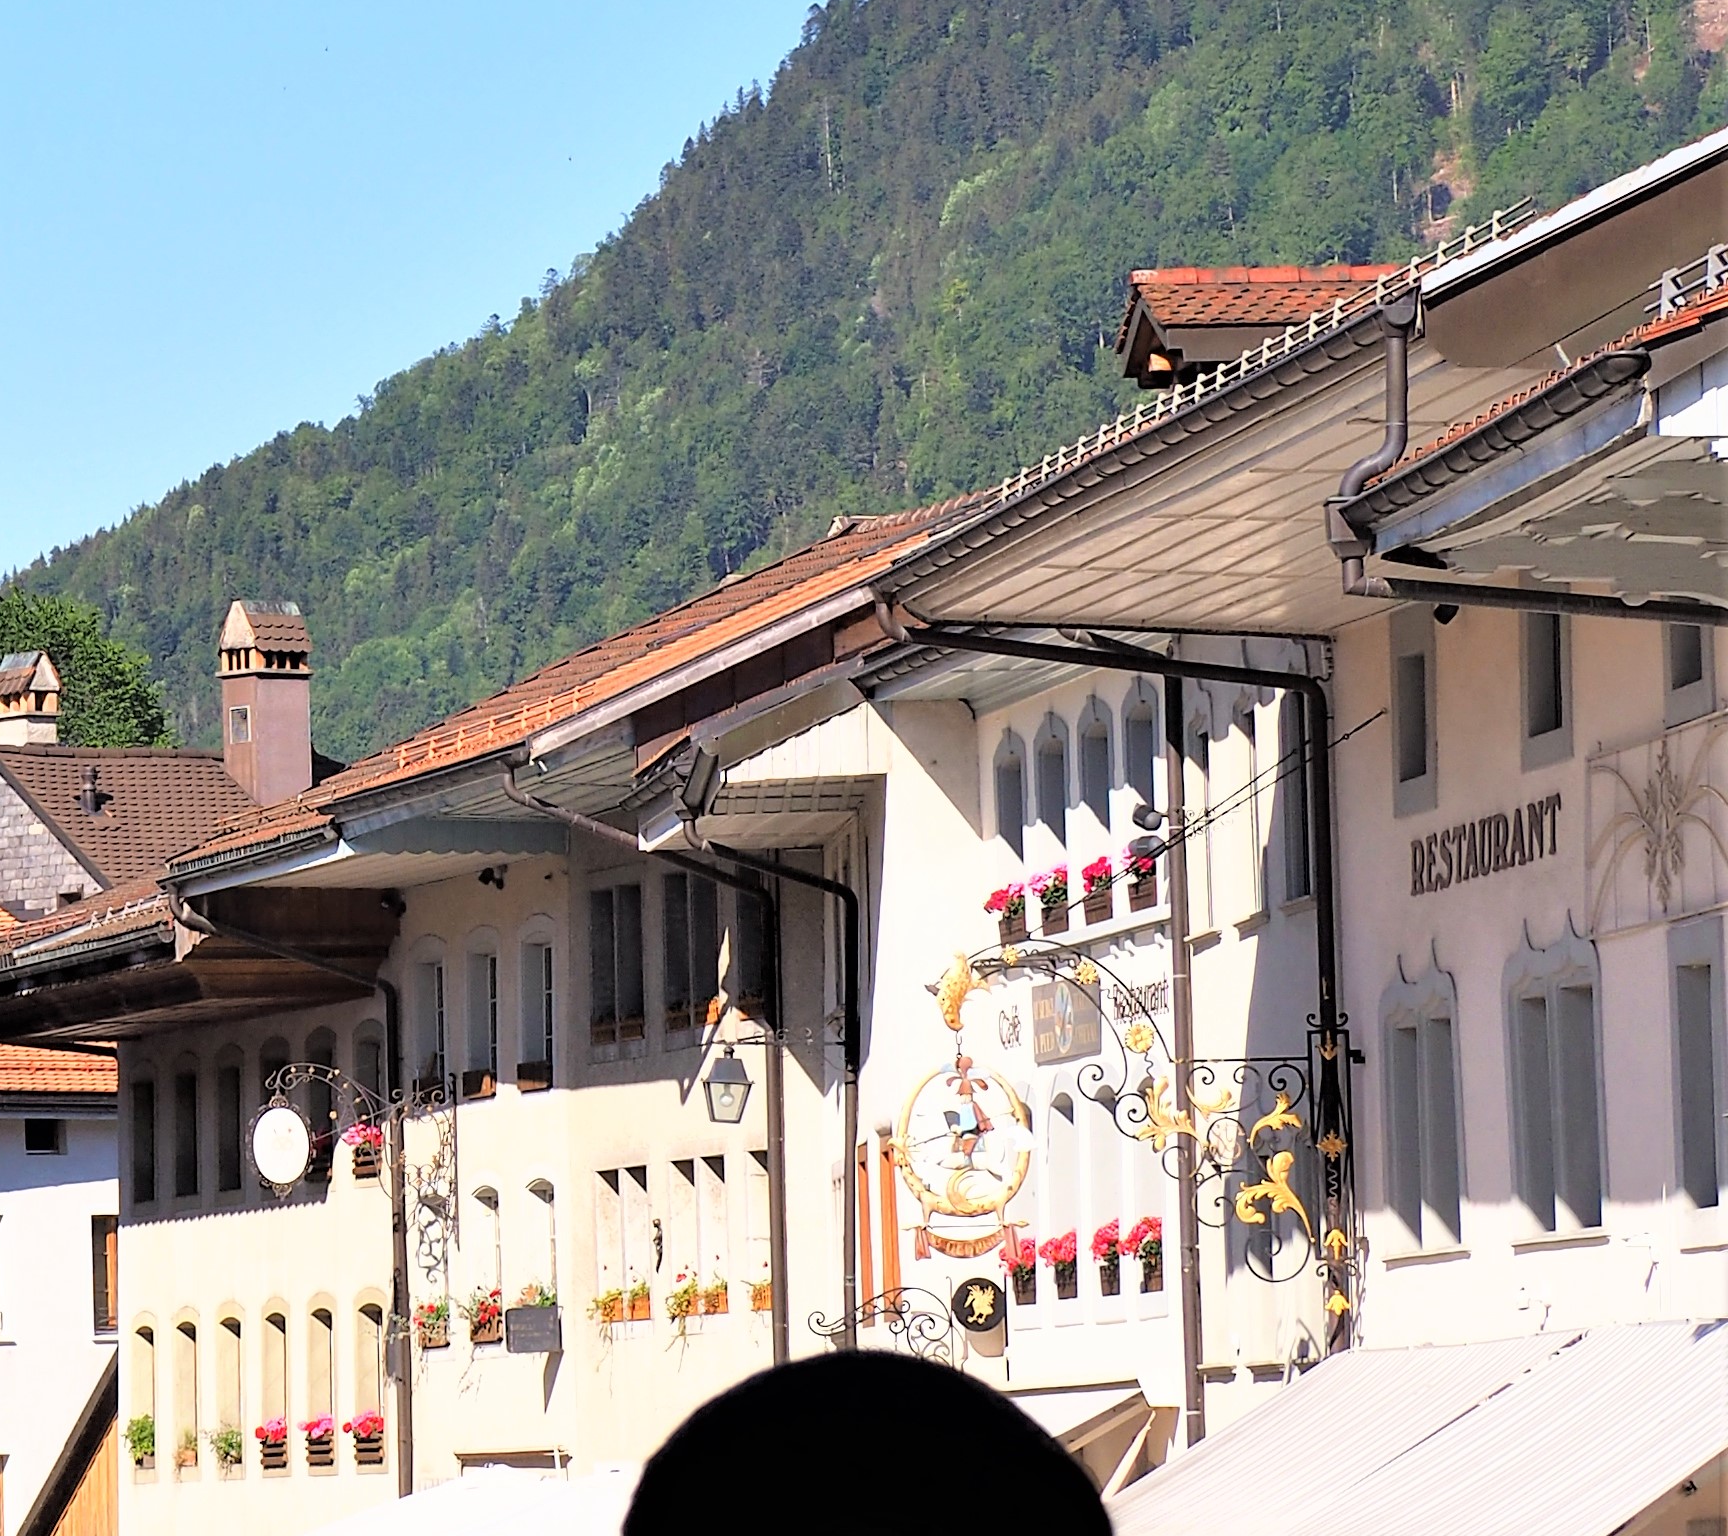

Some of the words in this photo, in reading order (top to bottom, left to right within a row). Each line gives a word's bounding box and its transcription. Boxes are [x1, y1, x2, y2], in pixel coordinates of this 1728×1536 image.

[1410, 793, 1562, 896] RESTAURANT
[1113, 972, 1169, 1021] Restaurant
[999, 1005, 1022, 1048] Café
